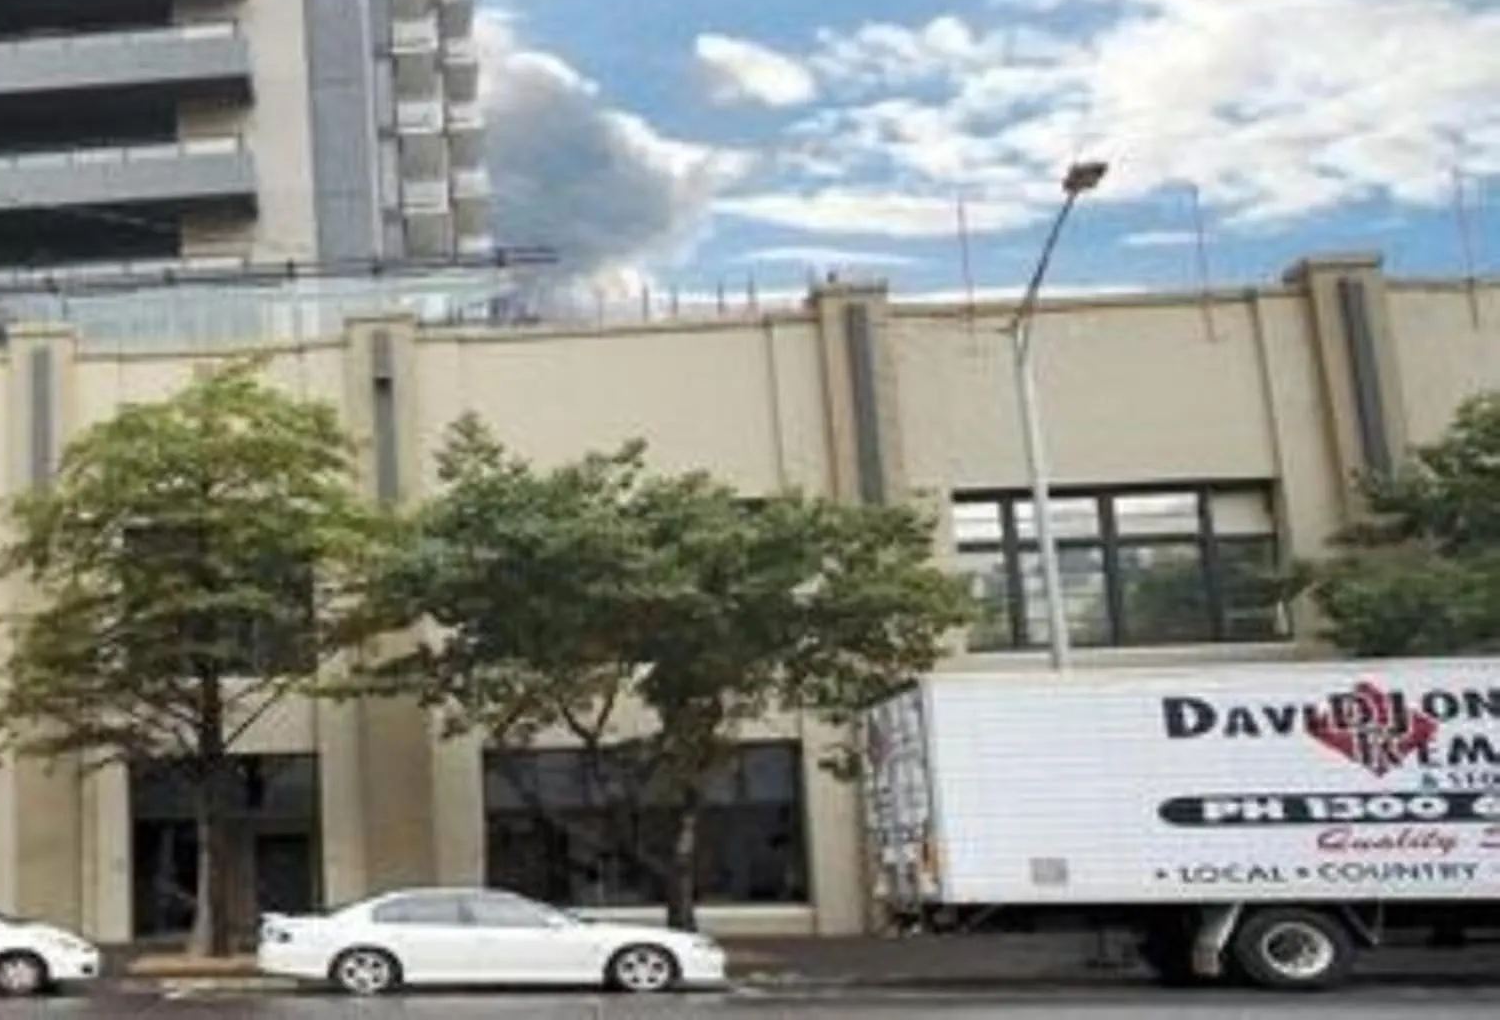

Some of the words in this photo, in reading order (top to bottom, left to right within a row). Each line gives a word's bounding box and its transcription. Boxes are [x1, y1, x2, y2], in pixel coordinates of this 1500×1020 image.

[1202, 798, 1285, 819] PH
[1304, 794, 1450, 820] 1300
[1316, 828, 1457, 854] Quality
[1178, 863, 1289, 884] LOCAL
[1316, 862, 1479, 883] COUNTRY
